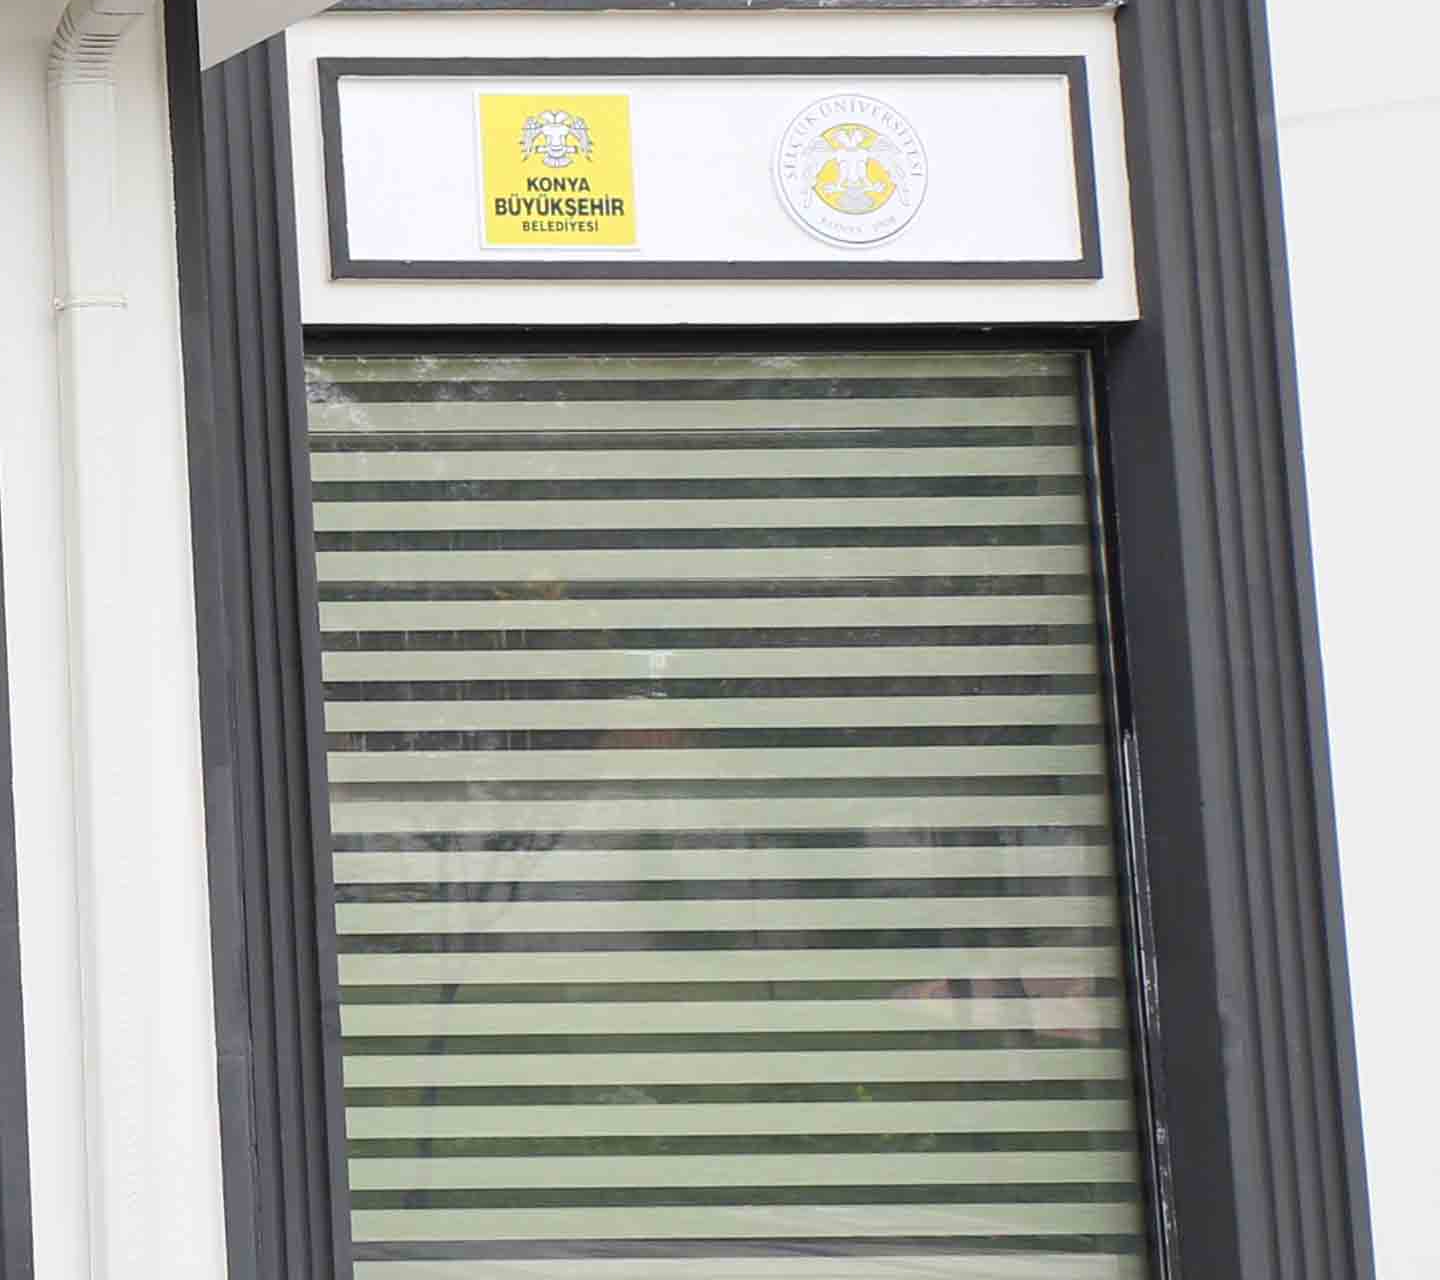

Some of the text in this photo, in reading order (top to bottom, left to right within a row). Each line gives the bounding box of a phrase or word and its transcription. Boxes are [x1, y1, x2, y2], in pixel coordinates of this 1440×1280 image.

[526, 176, 591, 193] KONYA
[494, 193, 625, 219] BÜYÜKŞEHİR
[521, 220, 599, 233] BELEDİYESİ
